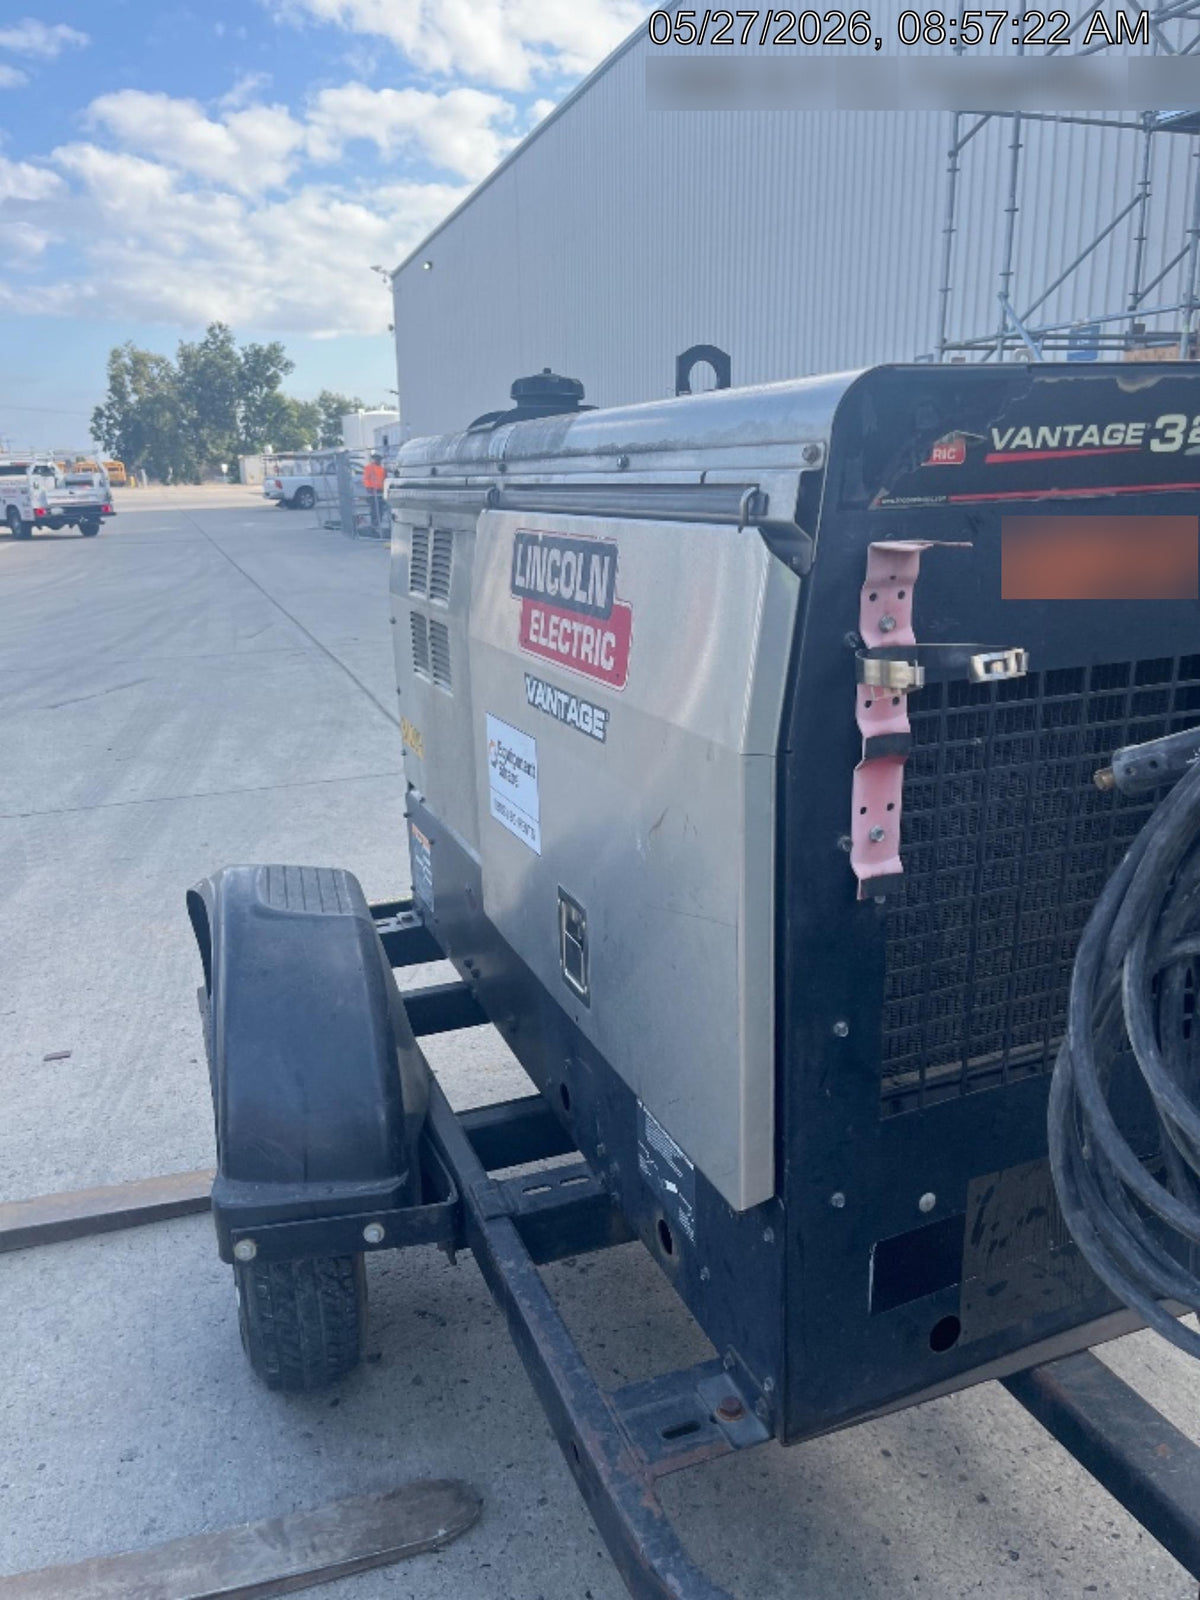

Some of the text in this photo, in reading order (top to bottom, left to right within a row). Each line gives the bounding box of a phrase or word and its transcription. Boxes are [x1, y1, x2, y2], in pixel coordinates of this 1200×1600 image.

[991, 422, 1146, 450] VANTAGE
[514, 543, 611, 608] LINCOLN
[528, 609, 616, 671] ELECTRIC
[525, 675, 606, 740] VANTAGE
